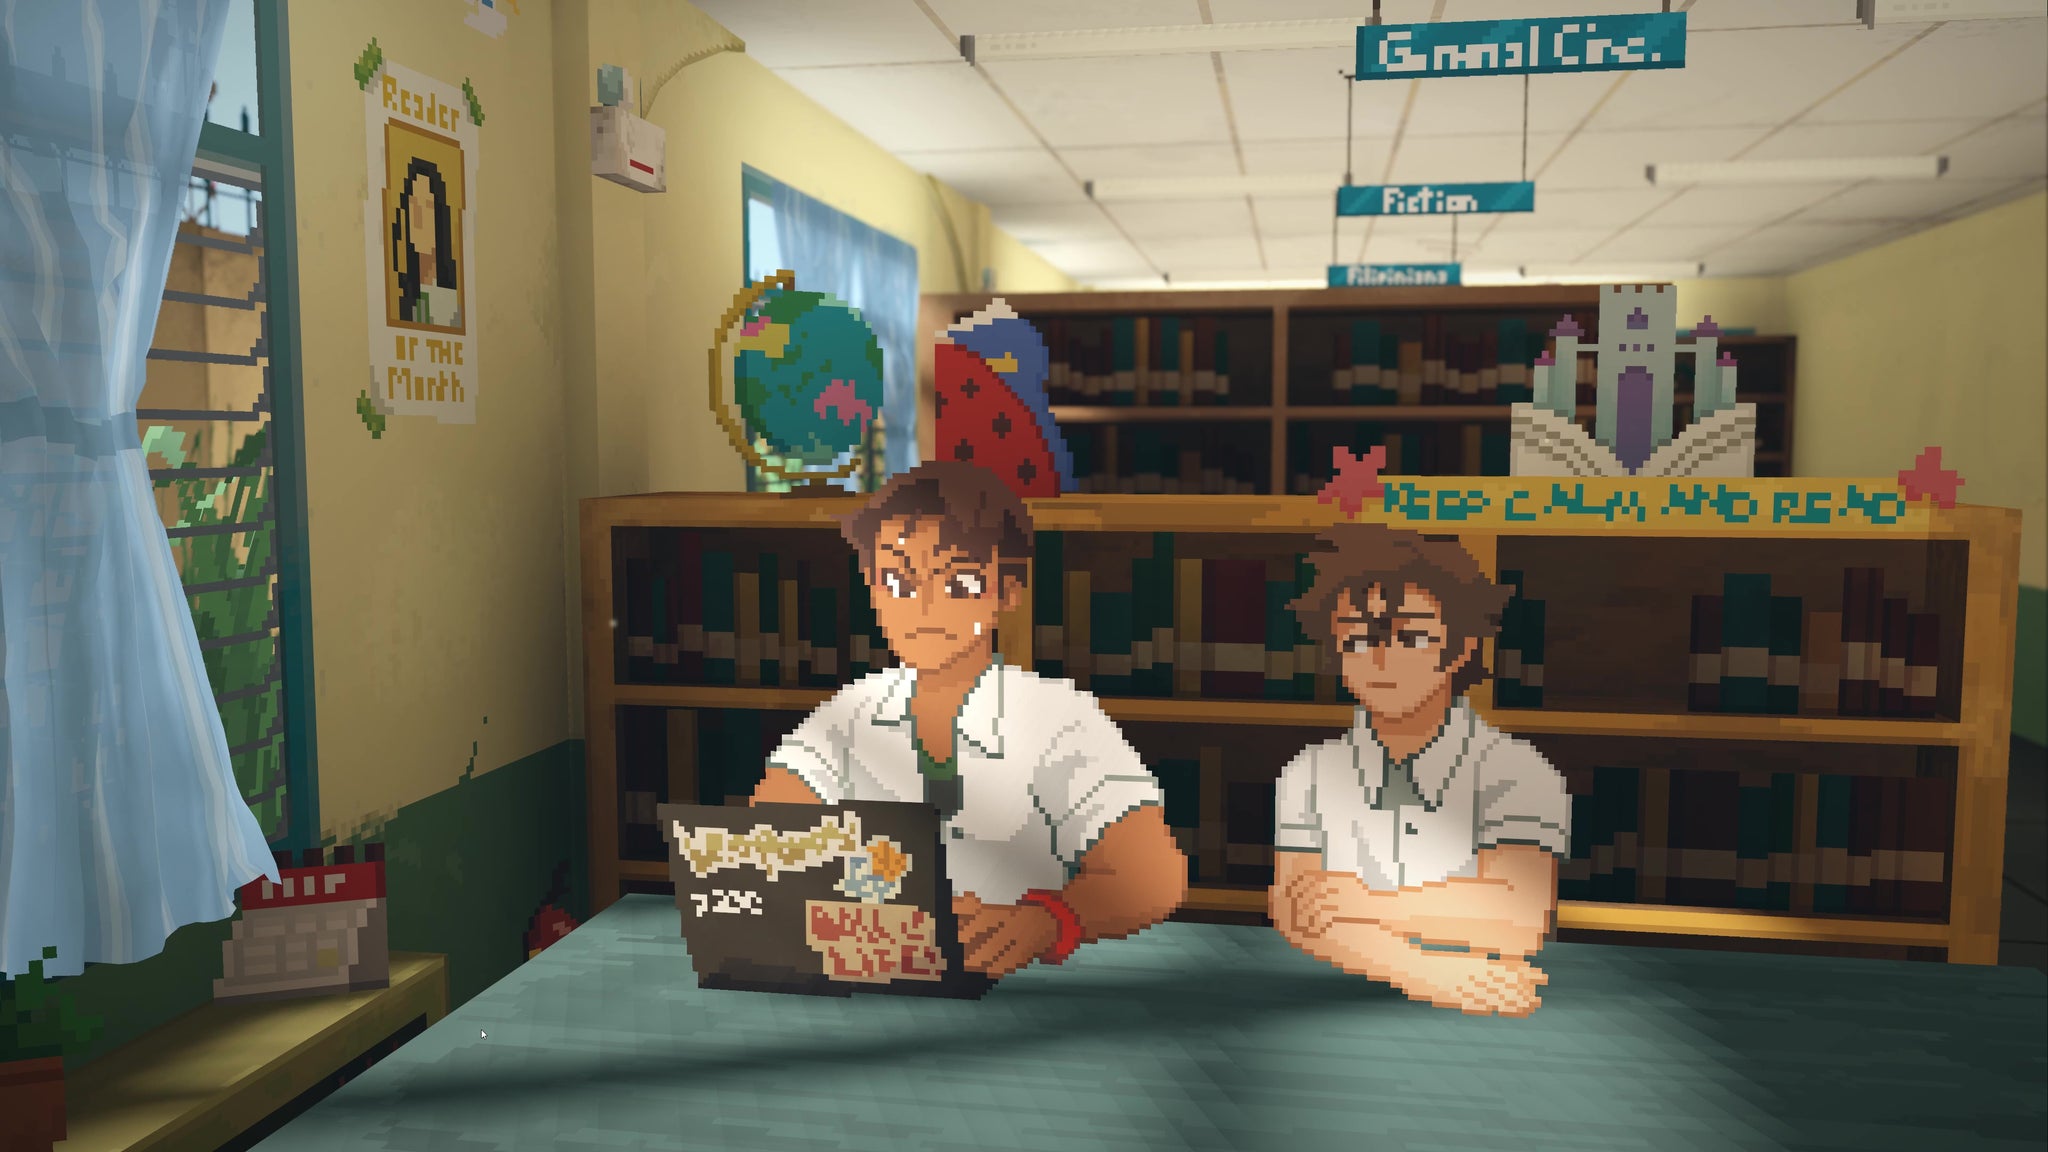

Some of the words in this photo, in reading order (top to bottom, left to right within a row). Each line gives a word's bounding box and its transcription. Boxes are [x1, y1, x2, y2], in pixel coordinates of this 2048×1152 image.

[382, 73, 460, 133] Reader
[1383, 186, 1478, 214] Fiction
[426, 338, 464, 365] THE
[388, 366, 465, 402] Month
